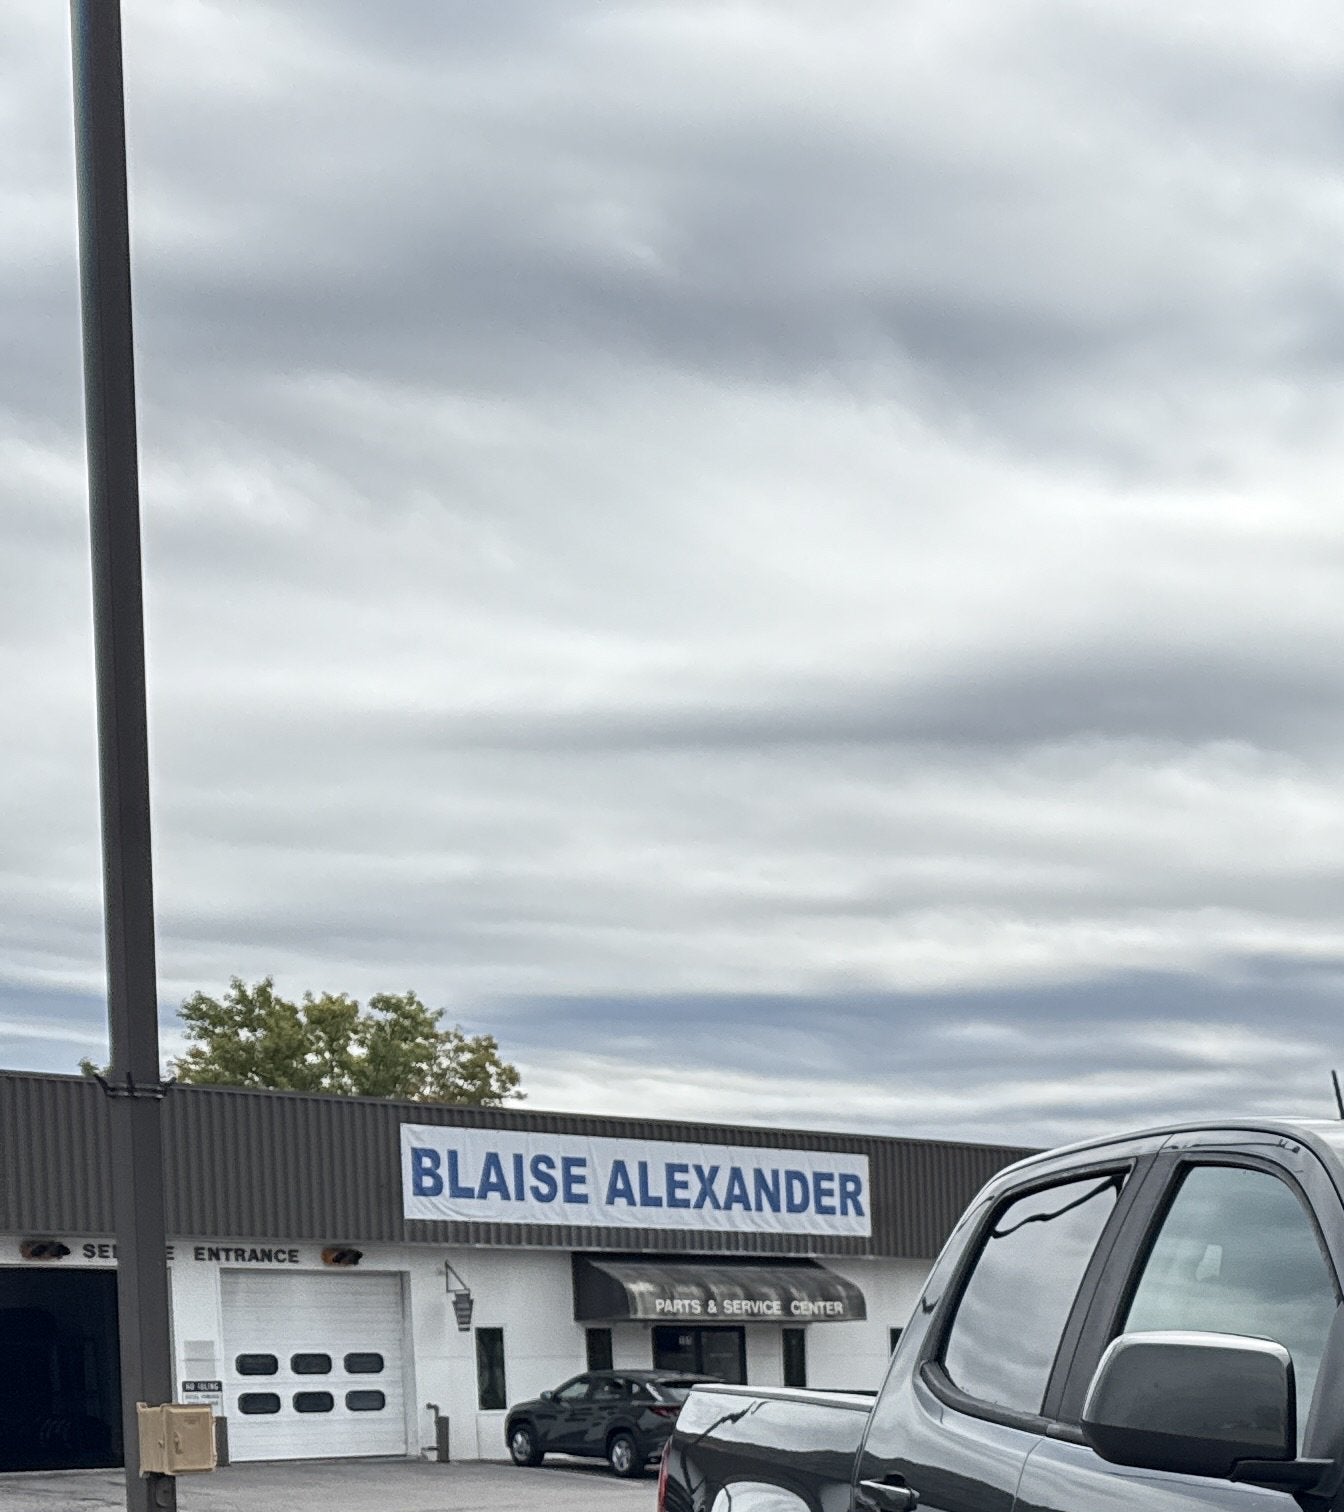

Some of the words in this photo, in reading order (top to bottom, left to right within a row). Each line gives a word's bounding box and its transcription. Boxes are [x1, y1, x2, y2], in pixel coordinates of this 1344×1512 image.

[410, 1147, 589, 1204] BLAISE
[604, 1158, 866, 1217] ALEXANDER
[194, 1245, 300, 1264] ENTRANCE
[655, 1298, 701, 1314] PARTS
[707, 1299, 718, 1314] &
[723, 1299, 782, 1315] SERVICE
[790, 1300, 844, 1316] CENTER
